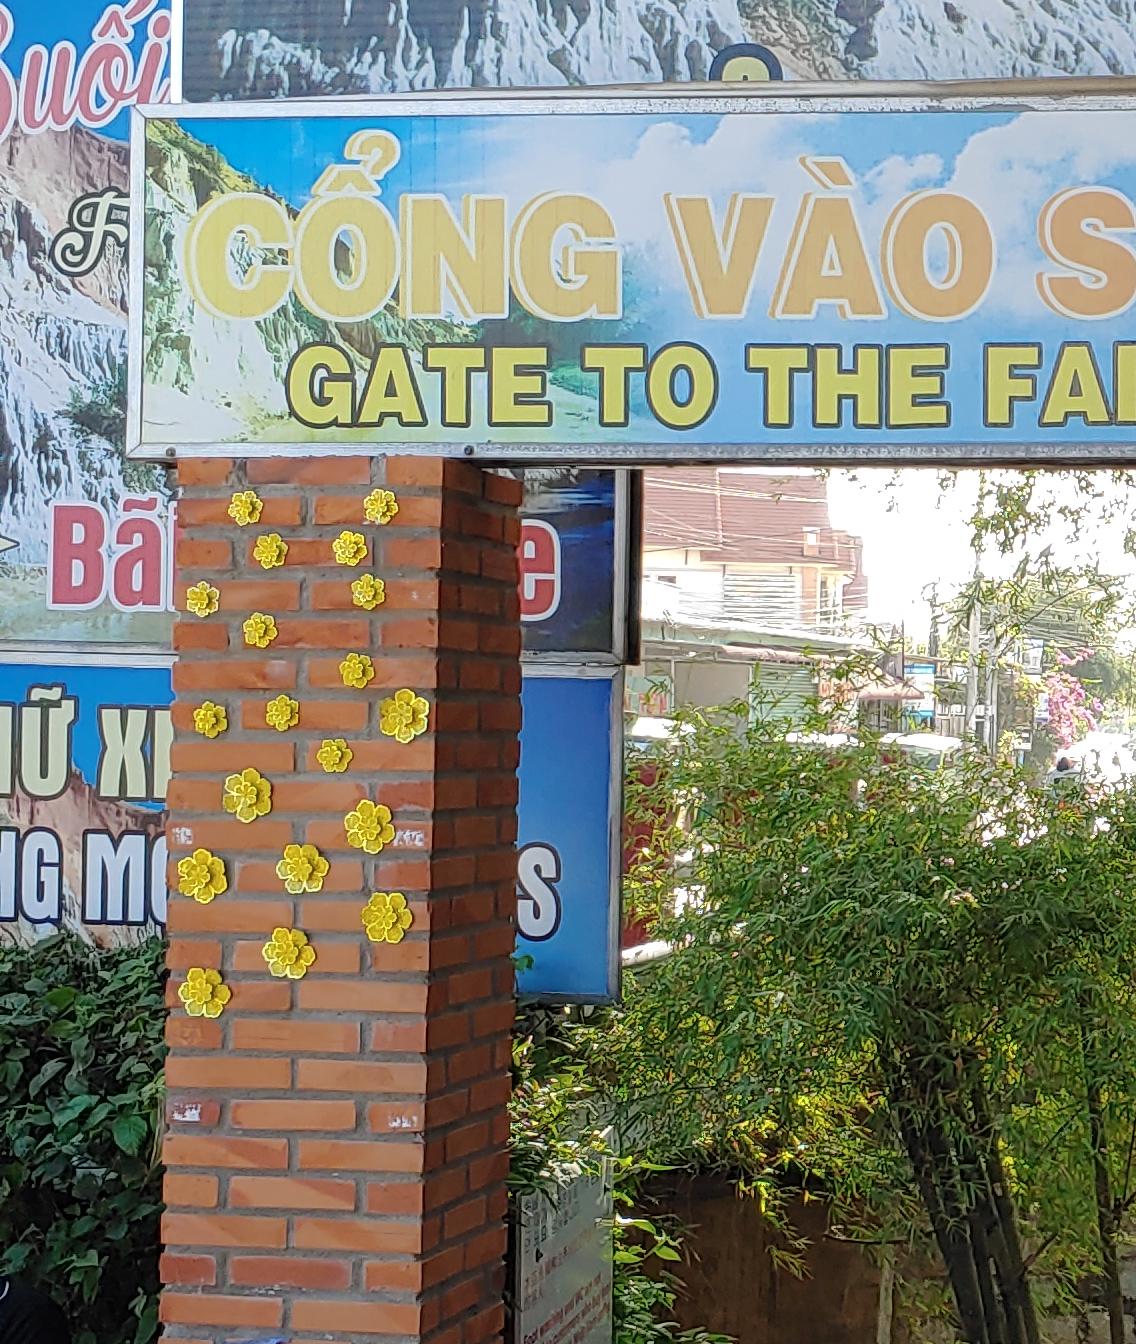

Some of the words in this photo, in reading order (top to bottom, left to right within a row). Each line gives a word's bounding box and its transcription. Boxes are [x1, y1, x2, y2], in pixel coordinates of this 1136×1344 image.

[184, 130, 623, 322] CỔNG
[664, 156, 994, 322] VÀO
[286, 343, 553, 429] GATE
[580, 342, 719, 430] TO
[745, 343, 951, 430] THE
[47, 497, 176, 612] Bã
